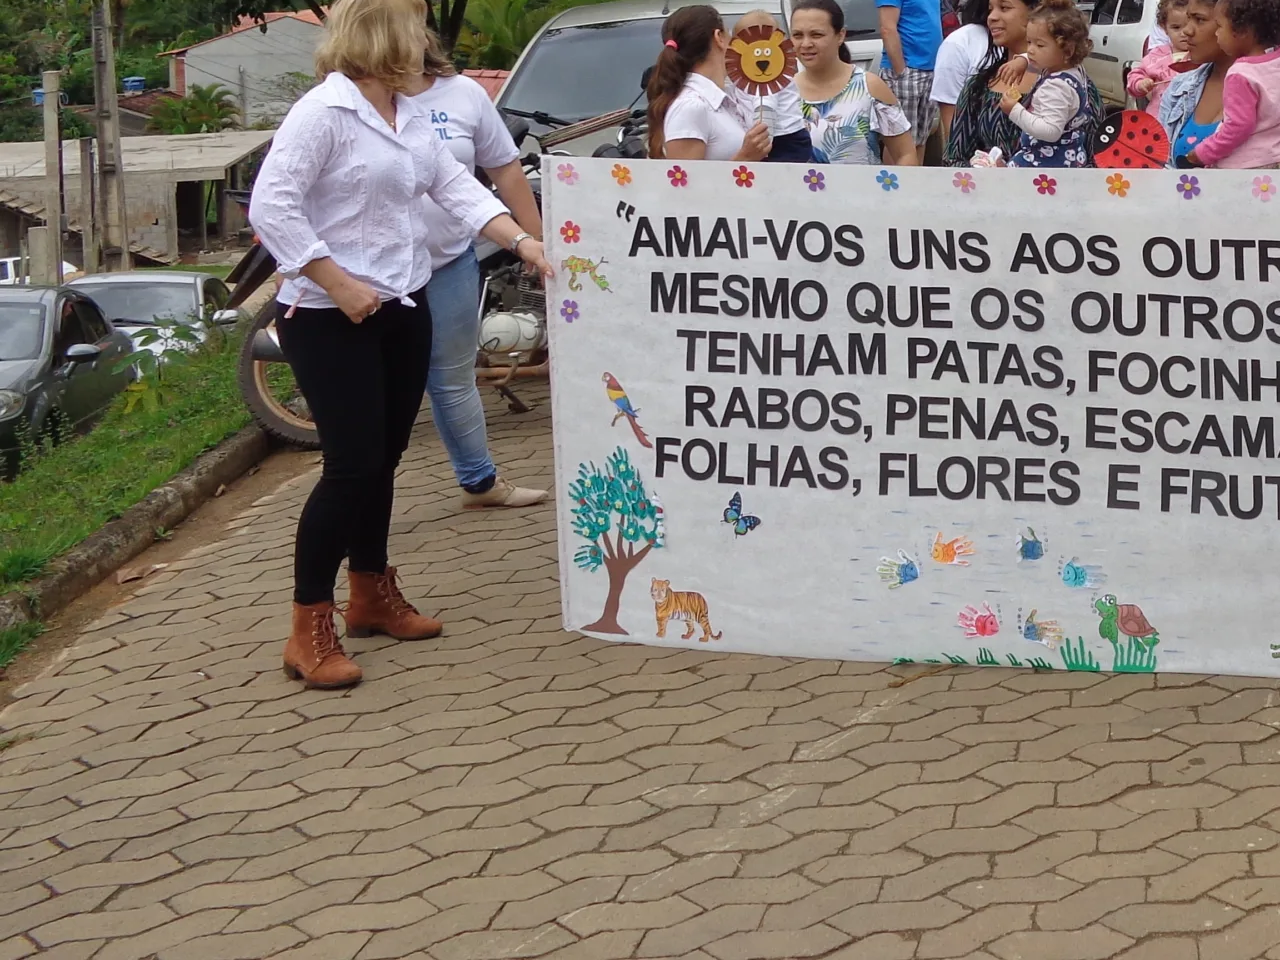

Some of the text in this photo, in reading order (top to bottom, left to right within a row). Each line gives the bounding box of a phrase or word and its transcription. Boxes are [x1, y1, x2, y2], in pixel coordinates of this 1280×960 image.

[888, 228, 991, 274] UNS
[1009, 232, 1121, 276] AOS
[650, 271, 829, 322] MESMO
[846, 281, 954, 329] QUE
[970, 286, 1045, 333] OS
[676, 329, 888, 377] TENHAM
[907, 337, 1077, 397] PATAS,
[685, 385, 874, 444] RABOS,
[885, 393, 1071, 455] PENAS,
[655, 436, 863, 498] FOLHAS,
[878, 452, 1081, 506] FLORES
[1106, 463, 1141, 511] E
